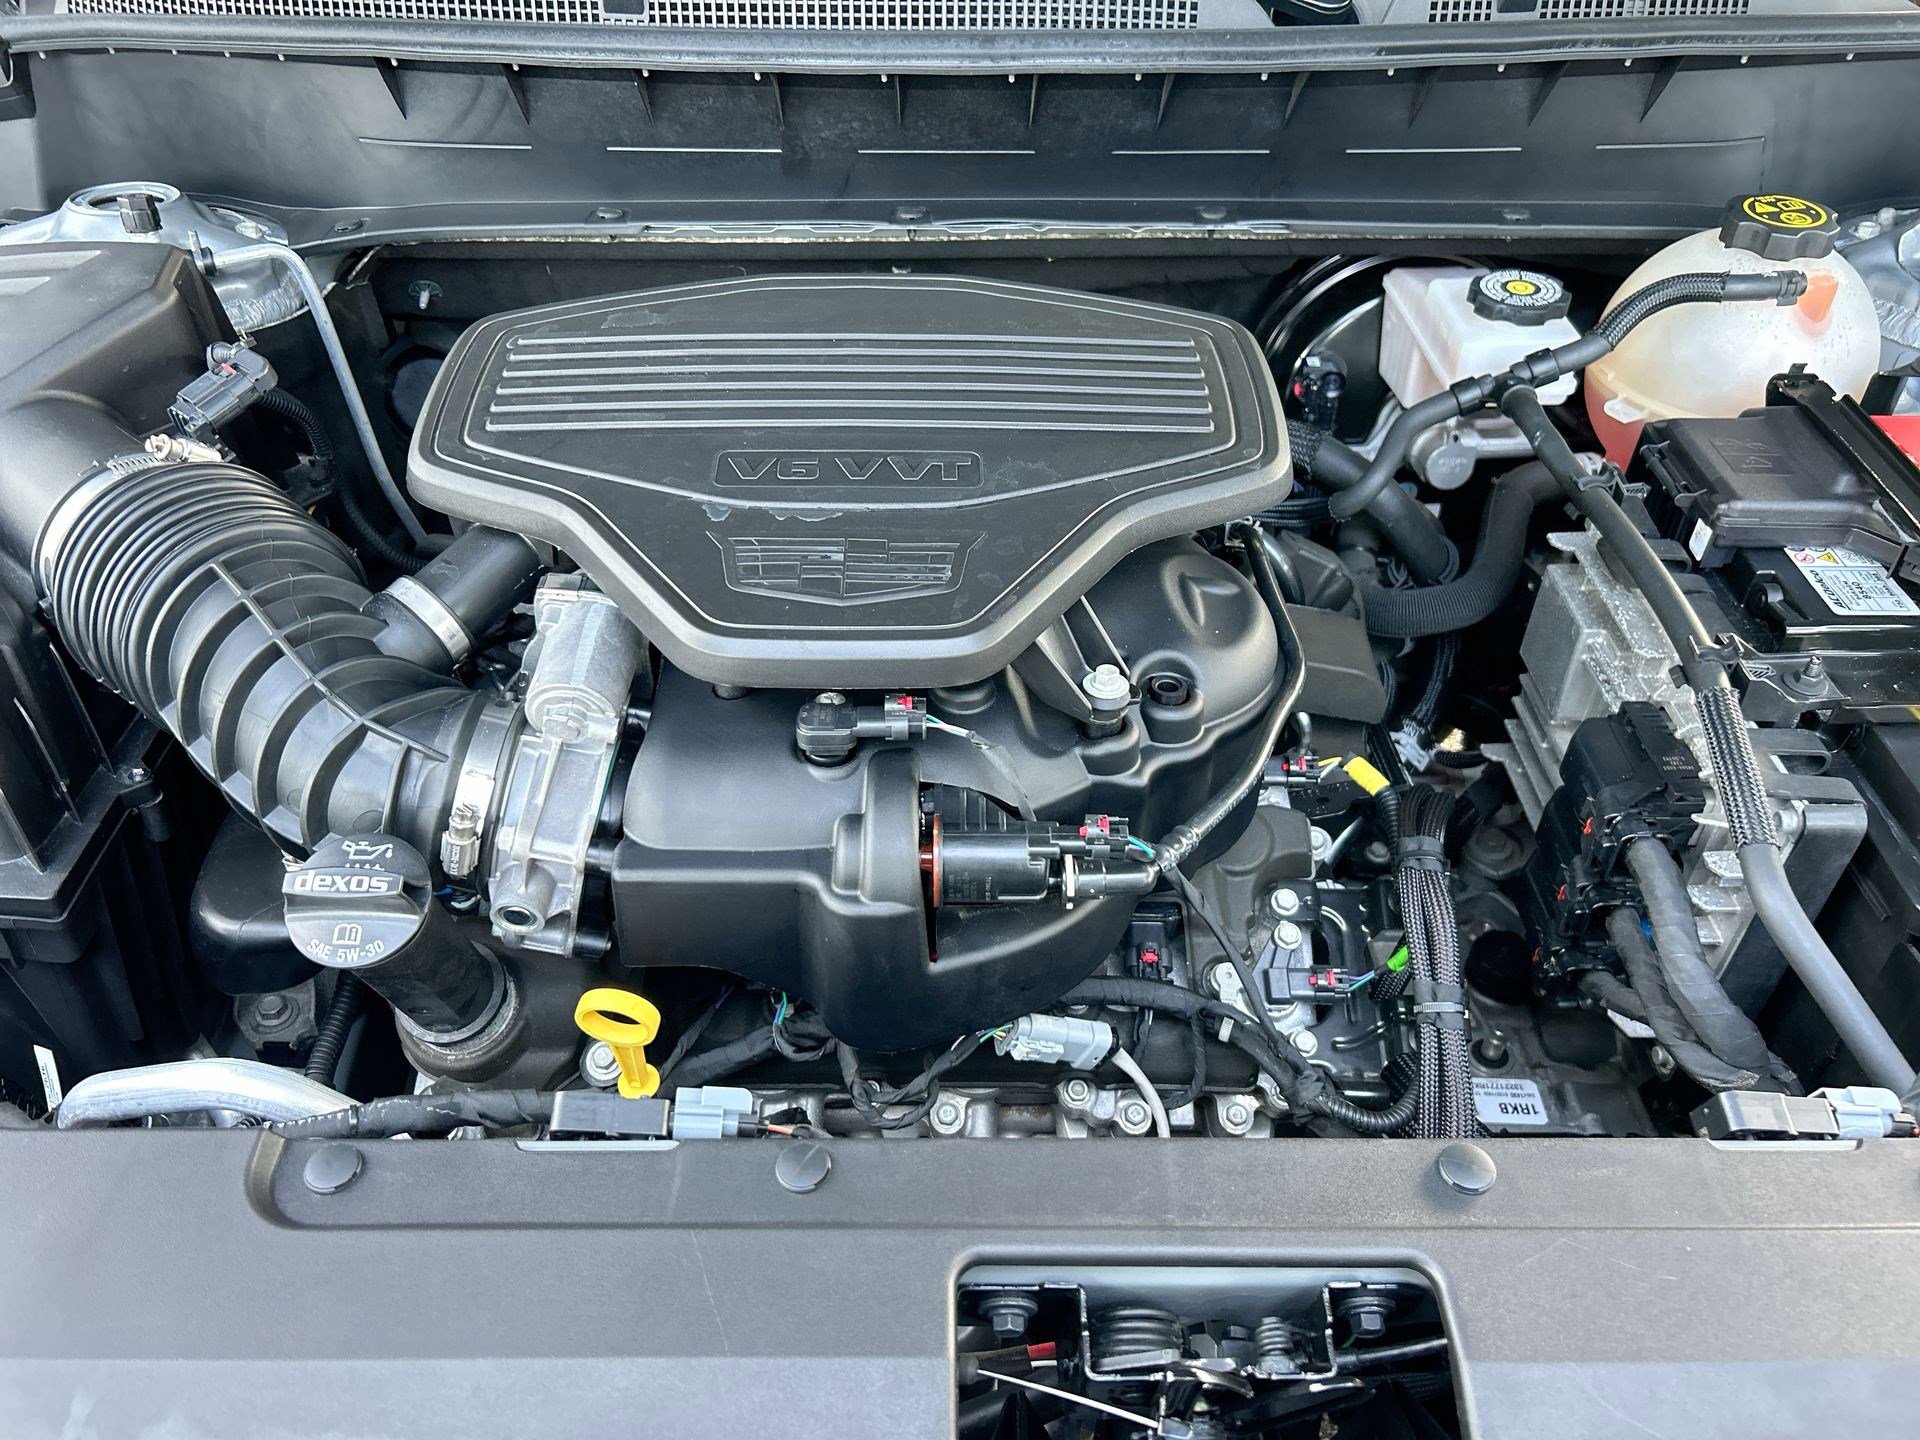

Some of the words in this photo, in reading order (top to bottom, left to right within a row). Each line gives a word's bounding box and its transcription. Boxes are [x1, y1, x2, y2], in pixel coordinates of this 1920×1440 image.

[727, 456, 820, 480] V6
[833, 456, 973, 481] VVT
[1809, 569, 1847, 609] ACDelco
[1851, 581, 1872, 600] 8540
[293, 869, 393, 893] dexos
[307, 938, 333, 959] SAE
[336, 940, 385, 963] 5W-30
[1499, 1102, 1540, 1115] 1RKB
